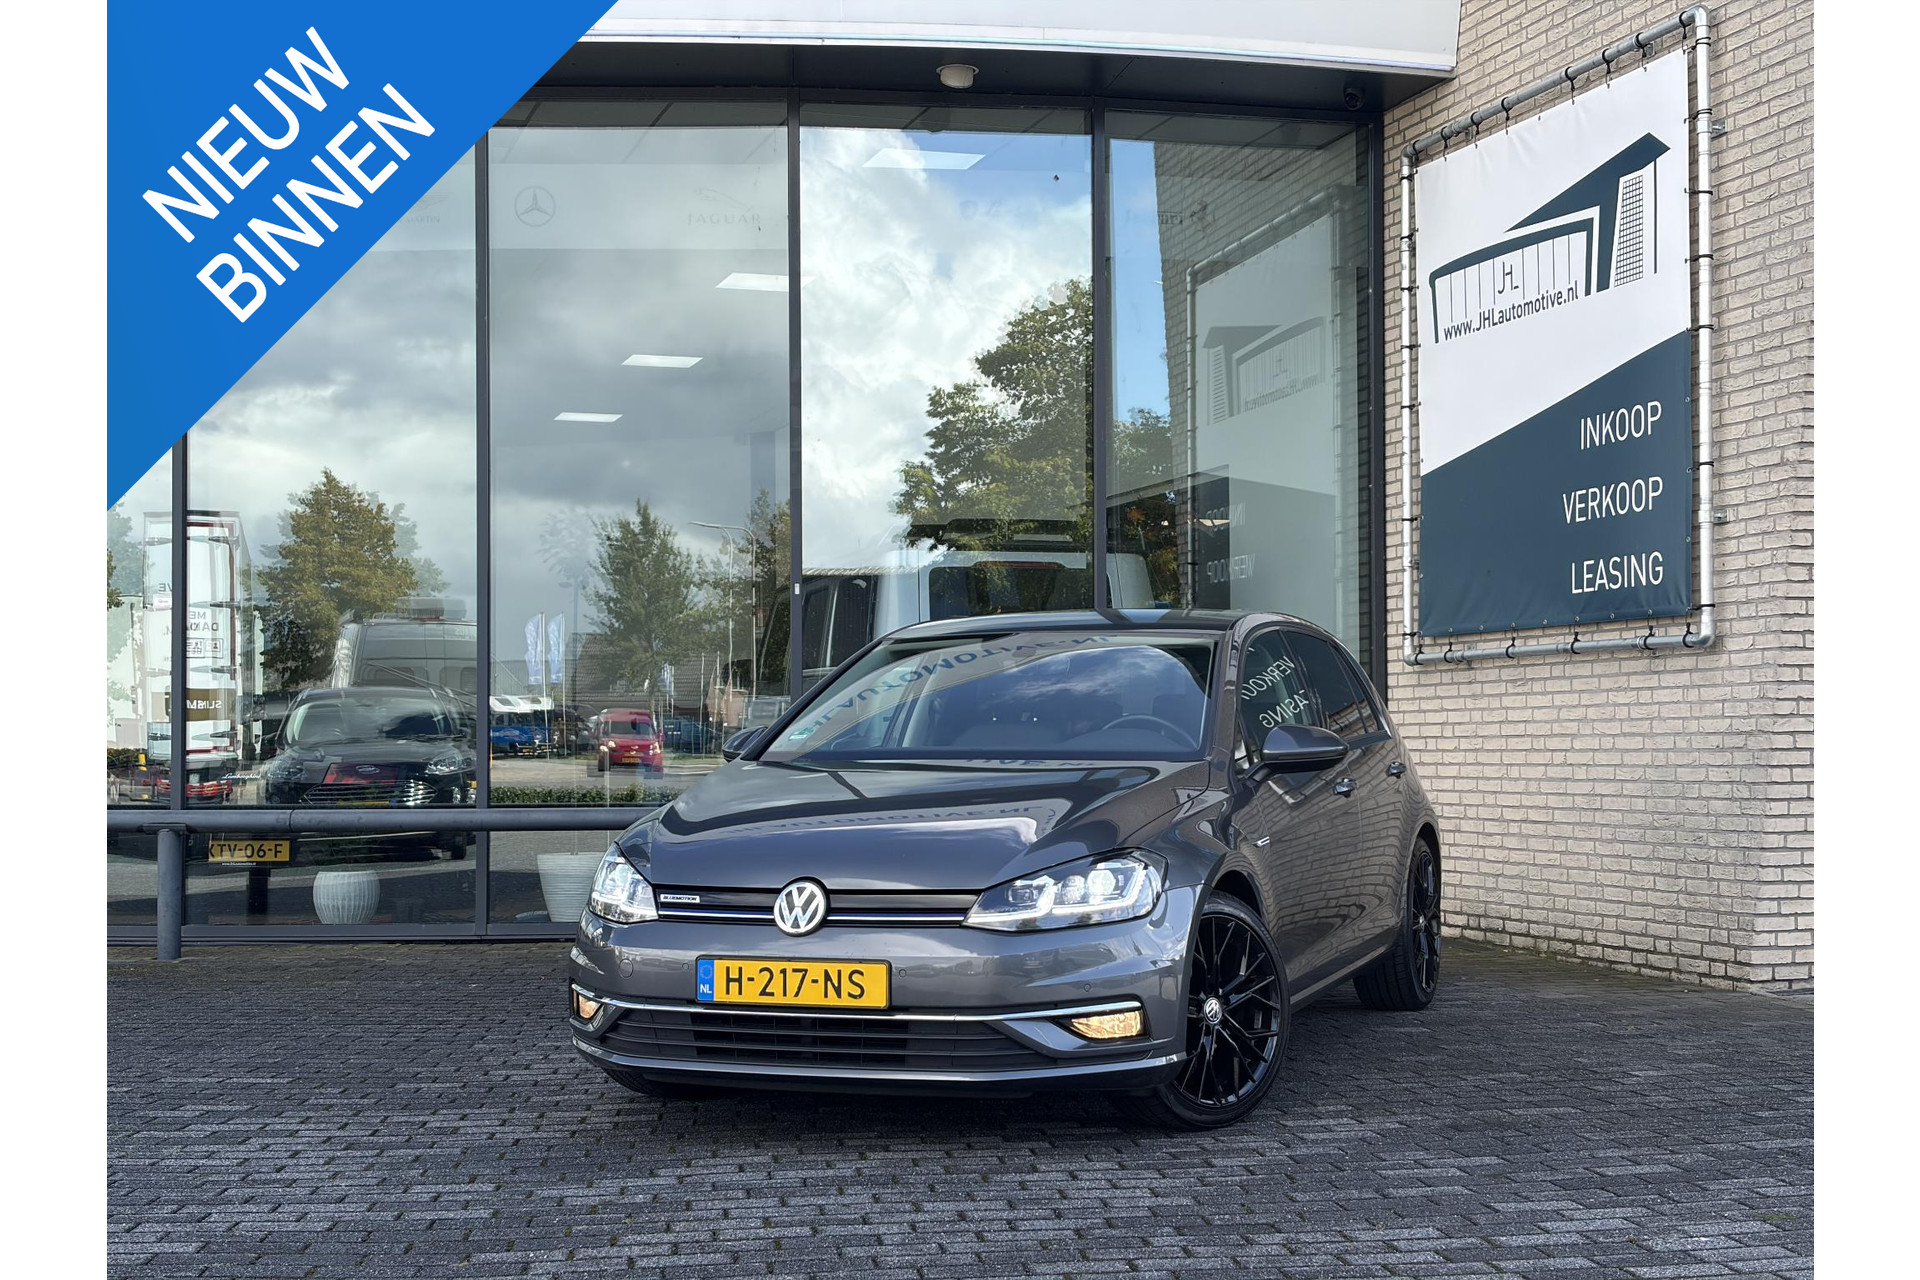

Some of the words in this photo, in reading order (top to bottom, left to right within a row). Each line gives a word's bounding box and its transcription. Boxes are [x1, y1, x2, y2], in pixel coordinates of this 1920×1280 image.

[687, 213, 761, 226] JAGUAR
[1497, 261, 1520, 295] JHL
[1443, 280, 1579, 341] www.JHLautomotive.nl
[1579, 400, 1662, 450] INKOOP
[1562, 475, 1663, 525] VERKOOP
[1570, 551, 1664, 594] LEASING
[700, 983, 712, 994] NL
[724, 965, 866, 1000] H-217-NS
